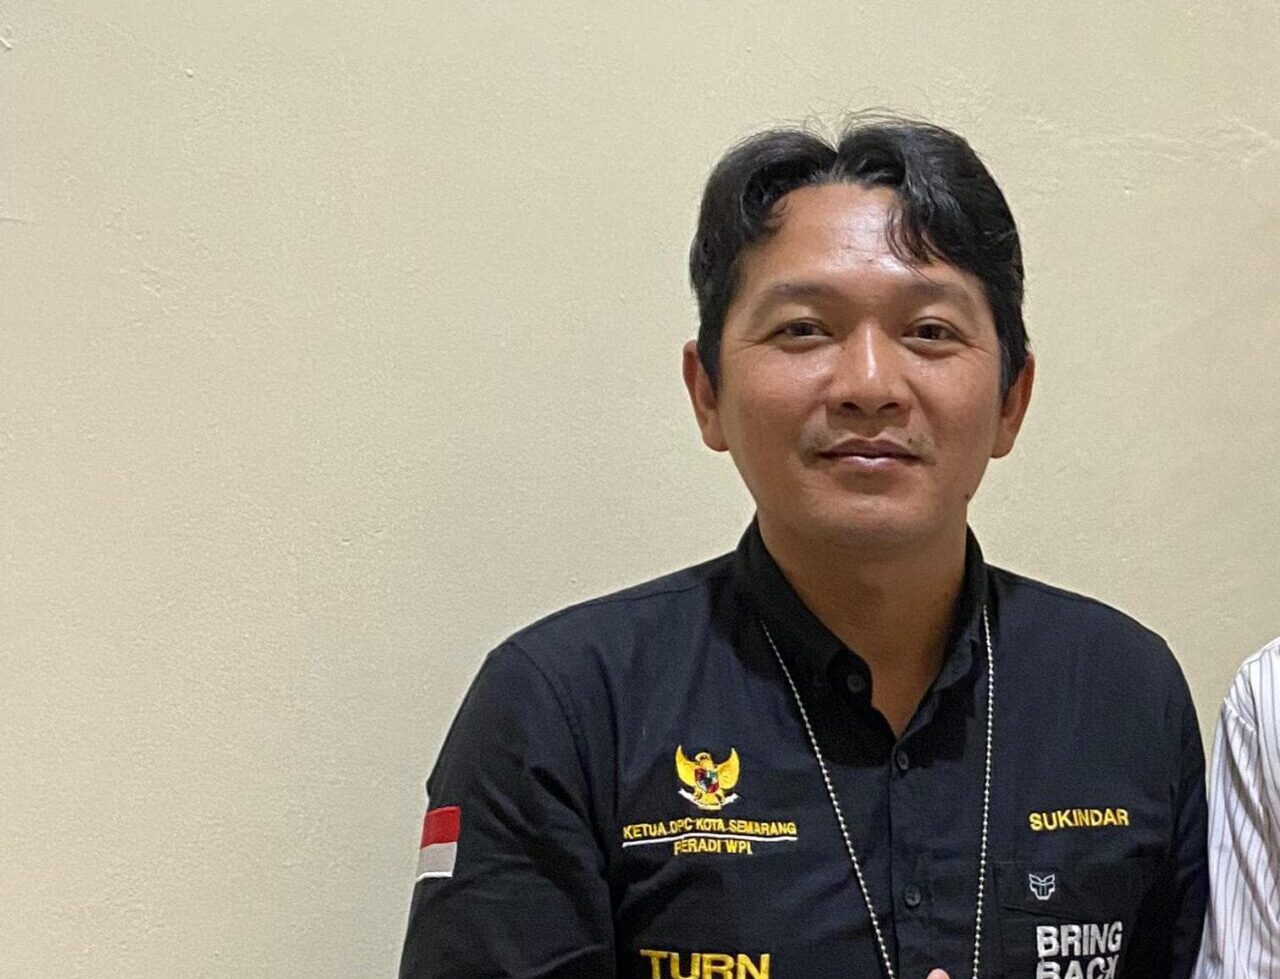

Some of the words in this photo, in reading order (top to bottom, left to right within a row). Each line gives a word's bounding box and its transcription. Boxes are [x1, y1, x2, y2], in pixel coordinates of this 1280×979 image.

[623, 821, 667, 839] KETUA
[669, 817, 693, 832] DPC
[696, 818, 725, 832] KOTA
[729, 820, 797, 836] SEMARANG
[1029, 808, 1130, 831] SUKINDAR
[1036, 921, 1123, 958] BRING
